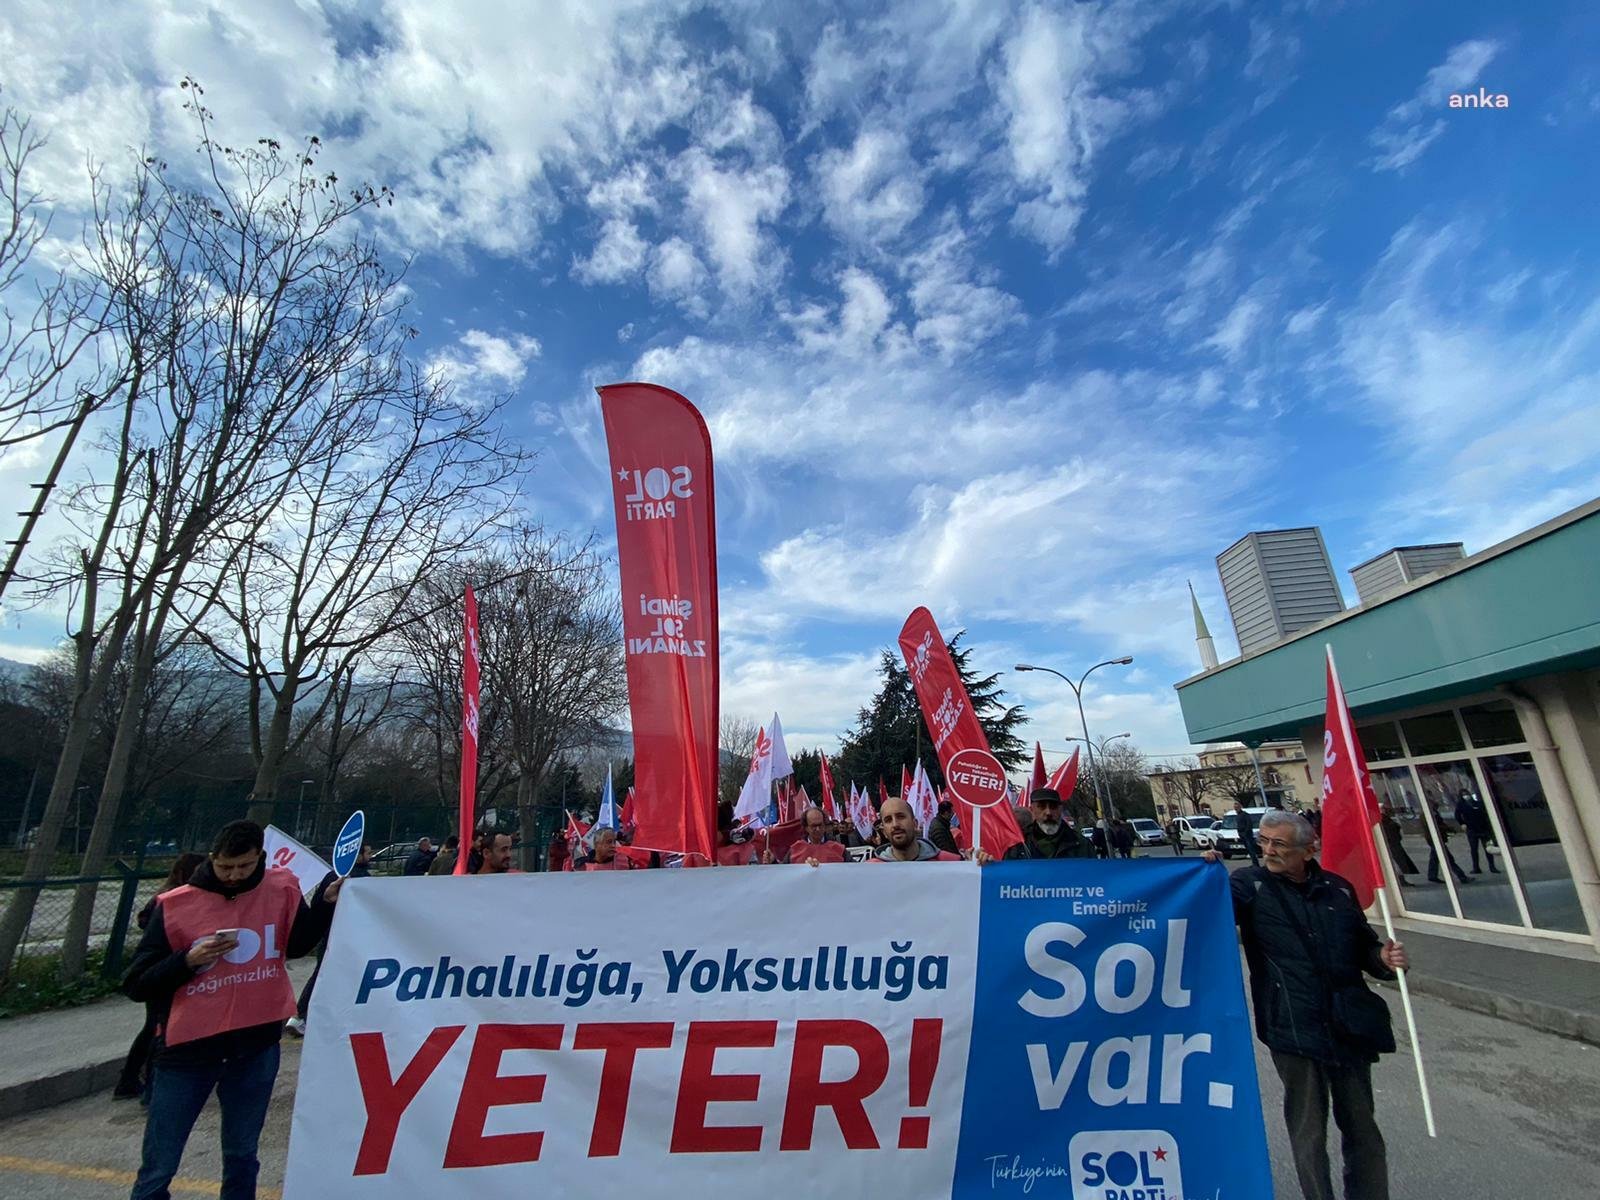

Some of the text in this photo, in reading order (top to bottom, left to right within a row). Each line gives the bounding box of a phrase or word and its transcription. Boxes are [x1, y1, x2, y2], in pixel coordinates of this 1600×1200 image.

[951, 770, 1004, 791] YETER!
[1000, 885, 1104, 899] Haklarımız ve
[1072, 899, 1148, 917] Emeğimiz
[1128, 915, 1156, 933] için
[355, 940, 949, 1007] Pahalılığa, Yoksulluğa
[1017, 918, 1191, 1018] Sol
[1026, 1032, 1234, 1111] var.
[349, 1017, 944, 1176] YETER!
[1081, 1151, 1164, 1187] SOL
